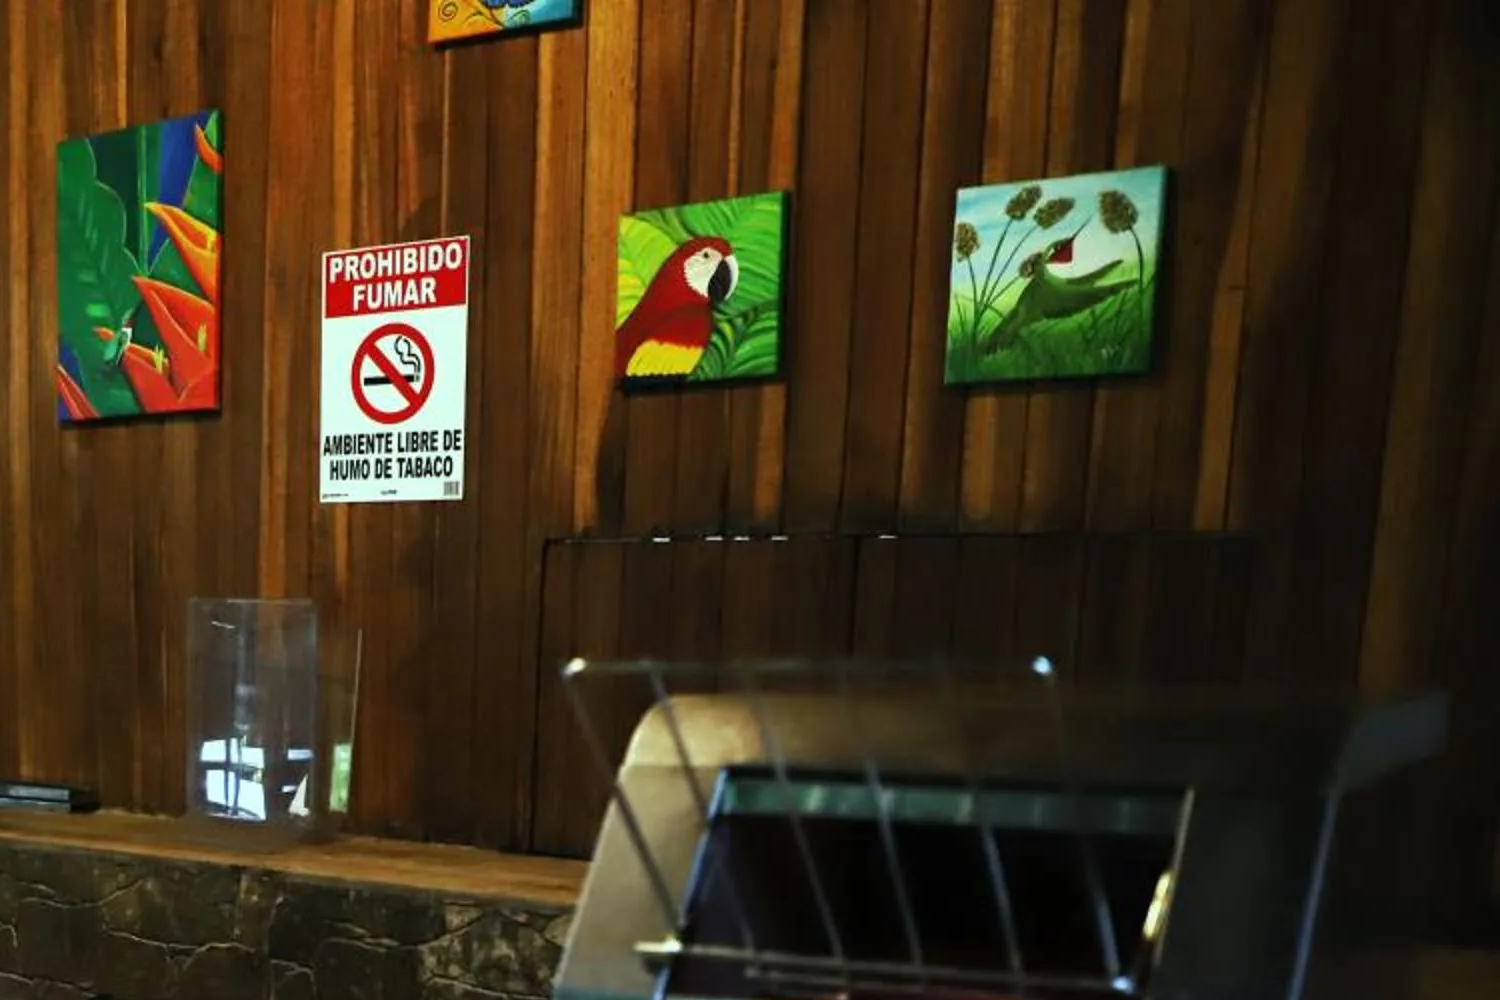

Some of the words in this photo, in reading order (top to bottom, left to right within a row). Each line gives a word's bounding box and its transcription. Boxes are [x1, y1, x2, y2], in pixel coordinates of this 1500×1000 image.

[329, 241, 463, 284] PROHIBIDO
[352, 277, 437, 312] FUMAR
[323, 432, 393, 456] AMBIENTE
[397, 430, 439, 453] LIBRE
[443, 429, 462, 451] DE
[329, 458, 370, 481] HUMO
[374, 458, 393, 479] DE
[397, 455, 454, 479] TABACO
